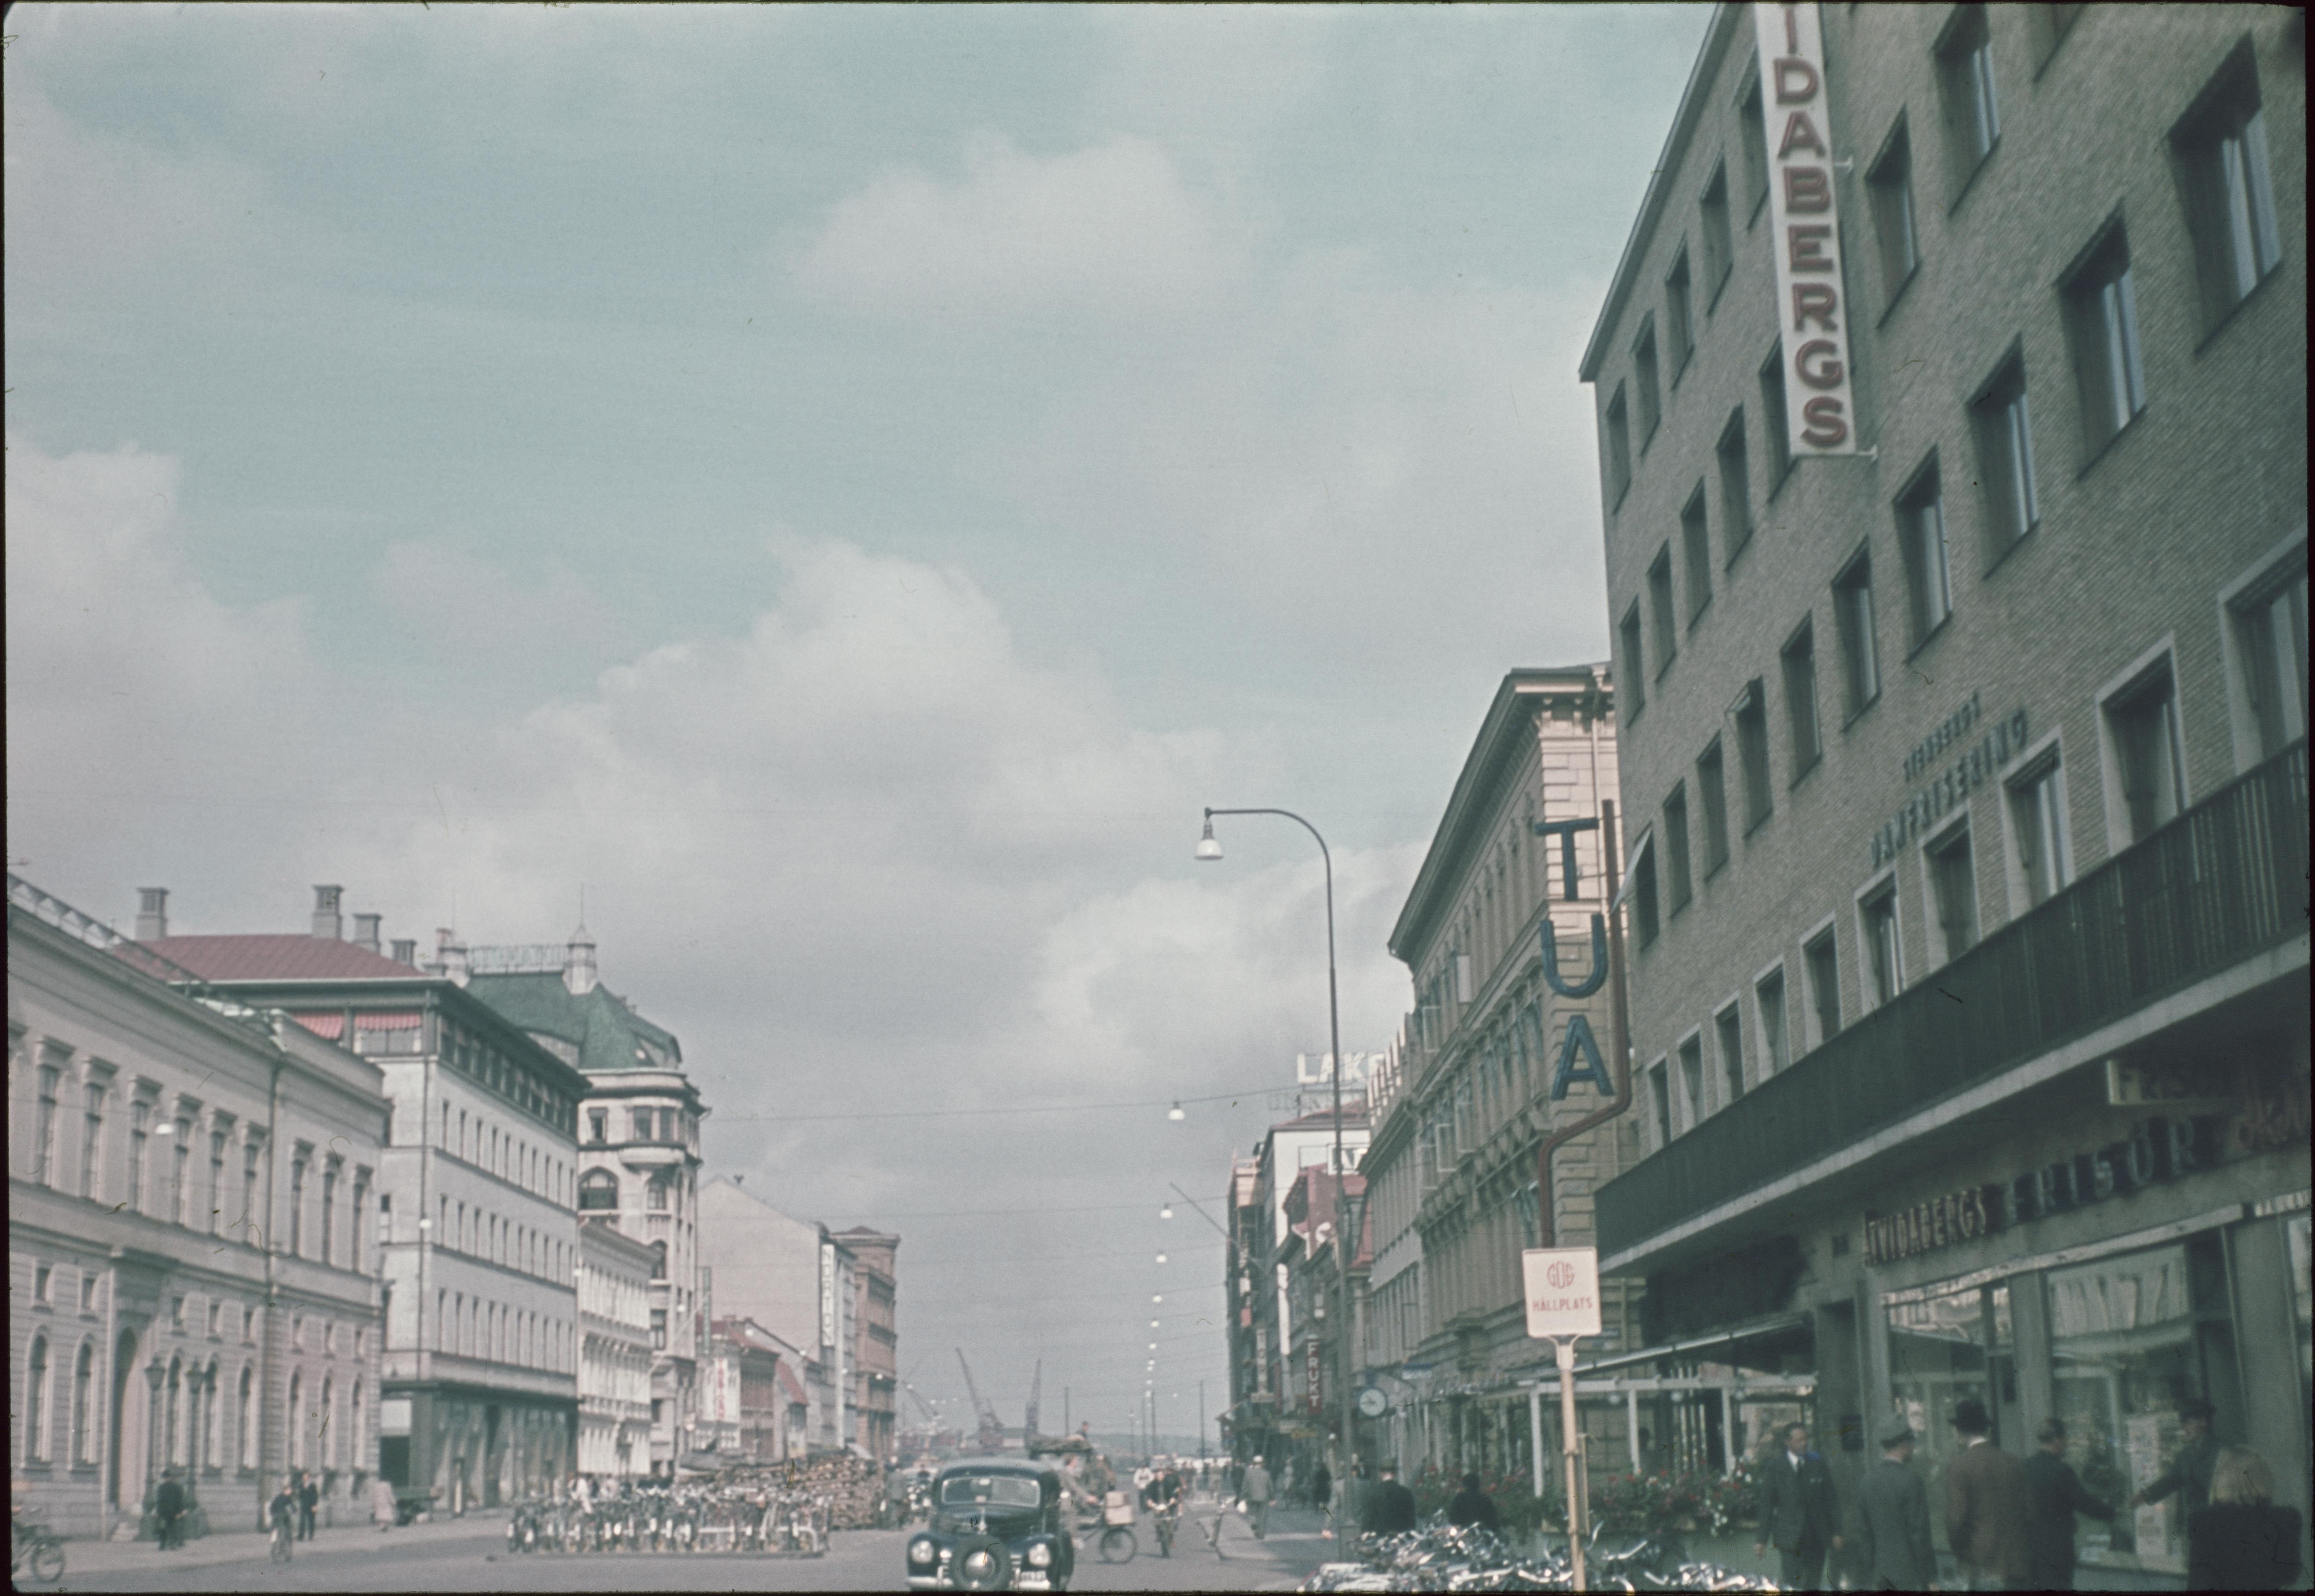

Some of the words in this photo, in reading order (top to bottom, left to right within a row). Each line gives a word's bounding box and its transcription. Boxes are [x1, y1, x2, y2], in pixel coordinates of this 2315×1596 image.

[1773, 4, 1848, 448] IDABERGS
[1533, 817, 1615, 1100] TUA
[1307, 1341, 1321, 1407] FRUKT
[1532, 1296, 1592, 1311] HÅLLPLATS
